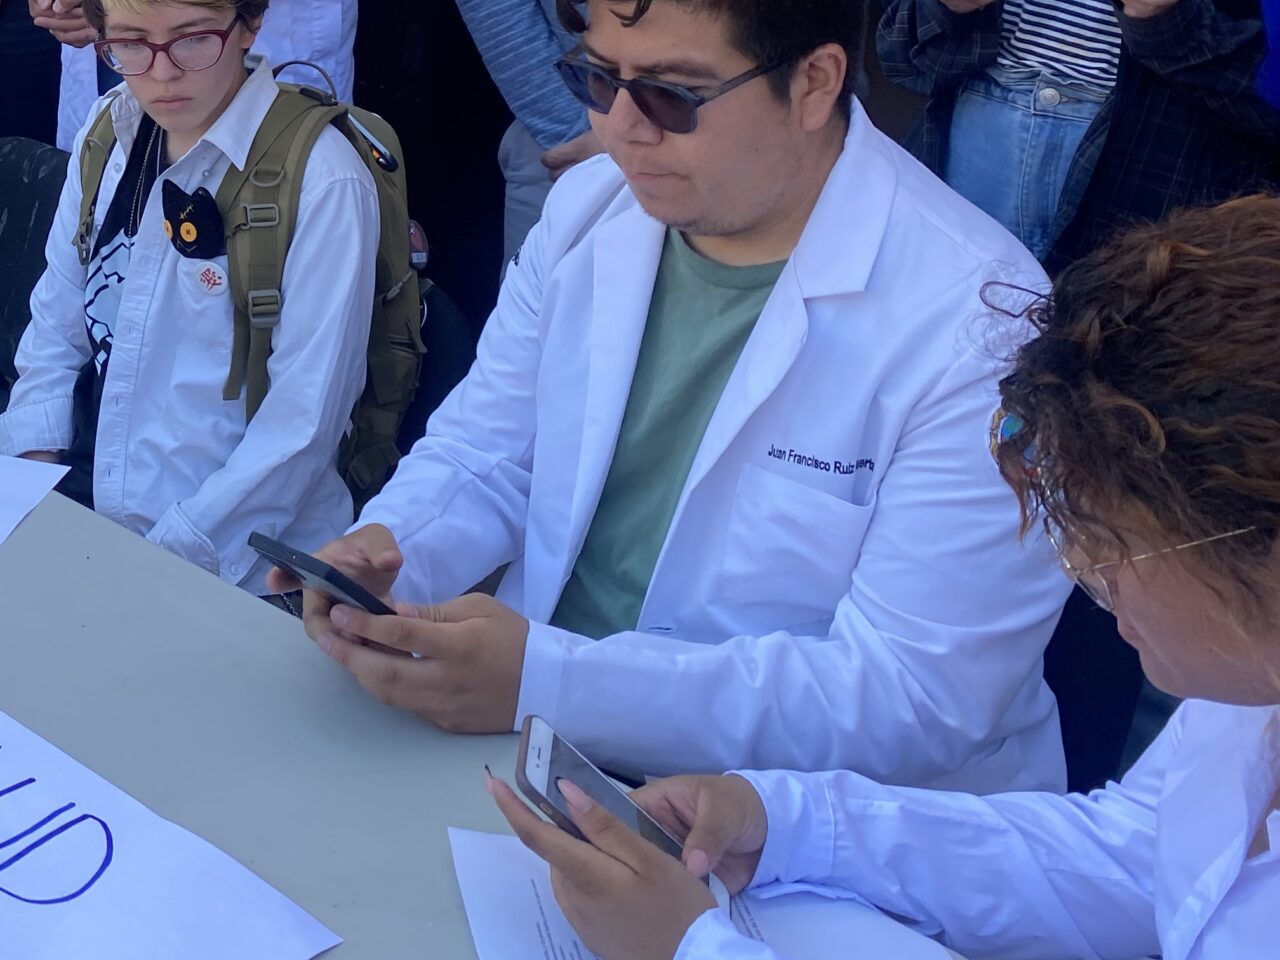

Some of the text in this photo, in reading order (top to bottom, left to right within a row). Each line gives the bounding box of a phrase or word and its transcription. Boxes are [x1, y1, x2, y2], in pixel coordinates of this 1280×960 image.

[768, 444, 786, 460] Juan
[787, 449, 830, 472] Francisco
[834, 461, 855, 474] Ruiz
